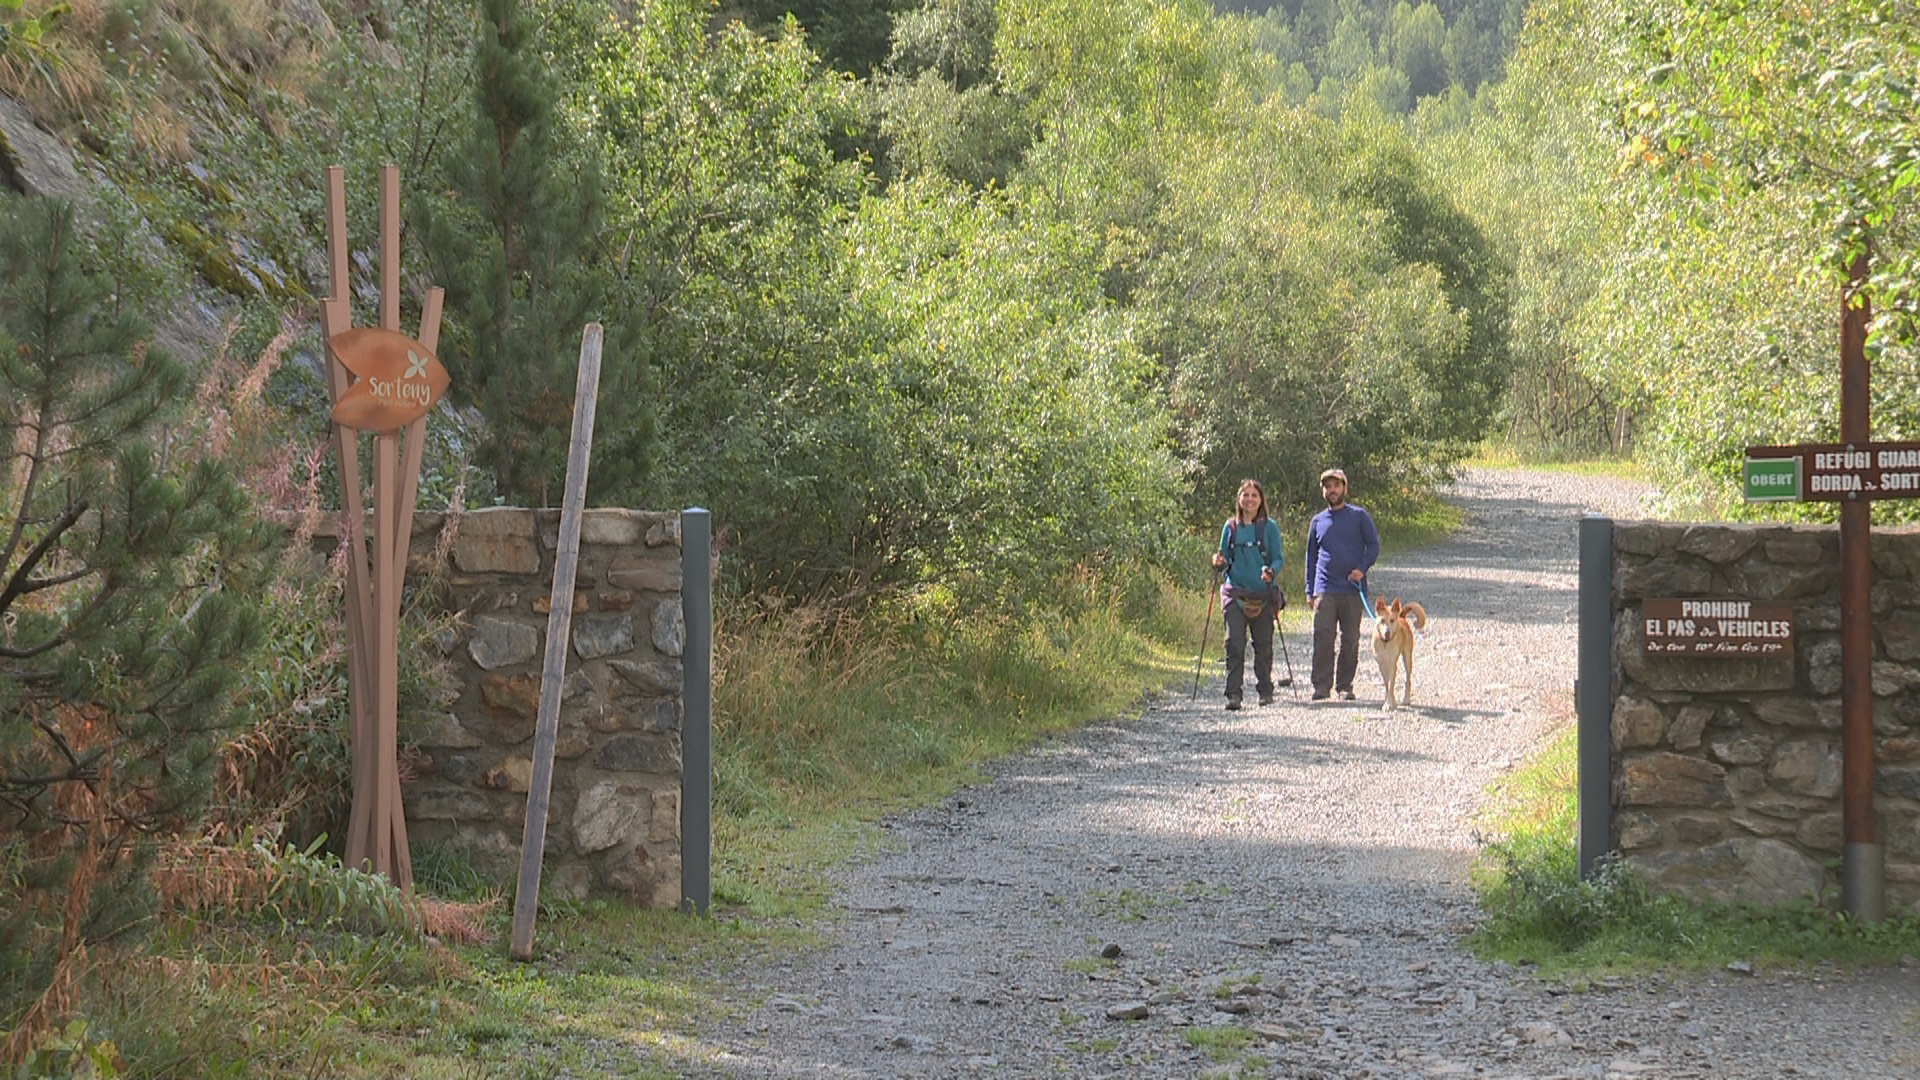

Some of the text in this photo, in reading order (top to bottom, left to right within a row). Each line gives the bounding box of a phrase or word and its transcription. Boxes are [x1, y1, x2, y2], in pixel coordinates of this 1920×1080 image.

[368, 376, 430, 407] Sorteny
[1815, 451, 1871, 470] REFUGI
[1750, 473, 1794, 487] OBERT
[1811, 474, 1863, 493] BORDA
[1682, 601, 1751, 619] PROHIBIT
[1646, 619, 1664, 636] EL
[1667, 619, 1696, 637] PAS
[1717, 620, 1790, 638] VEHICLES
